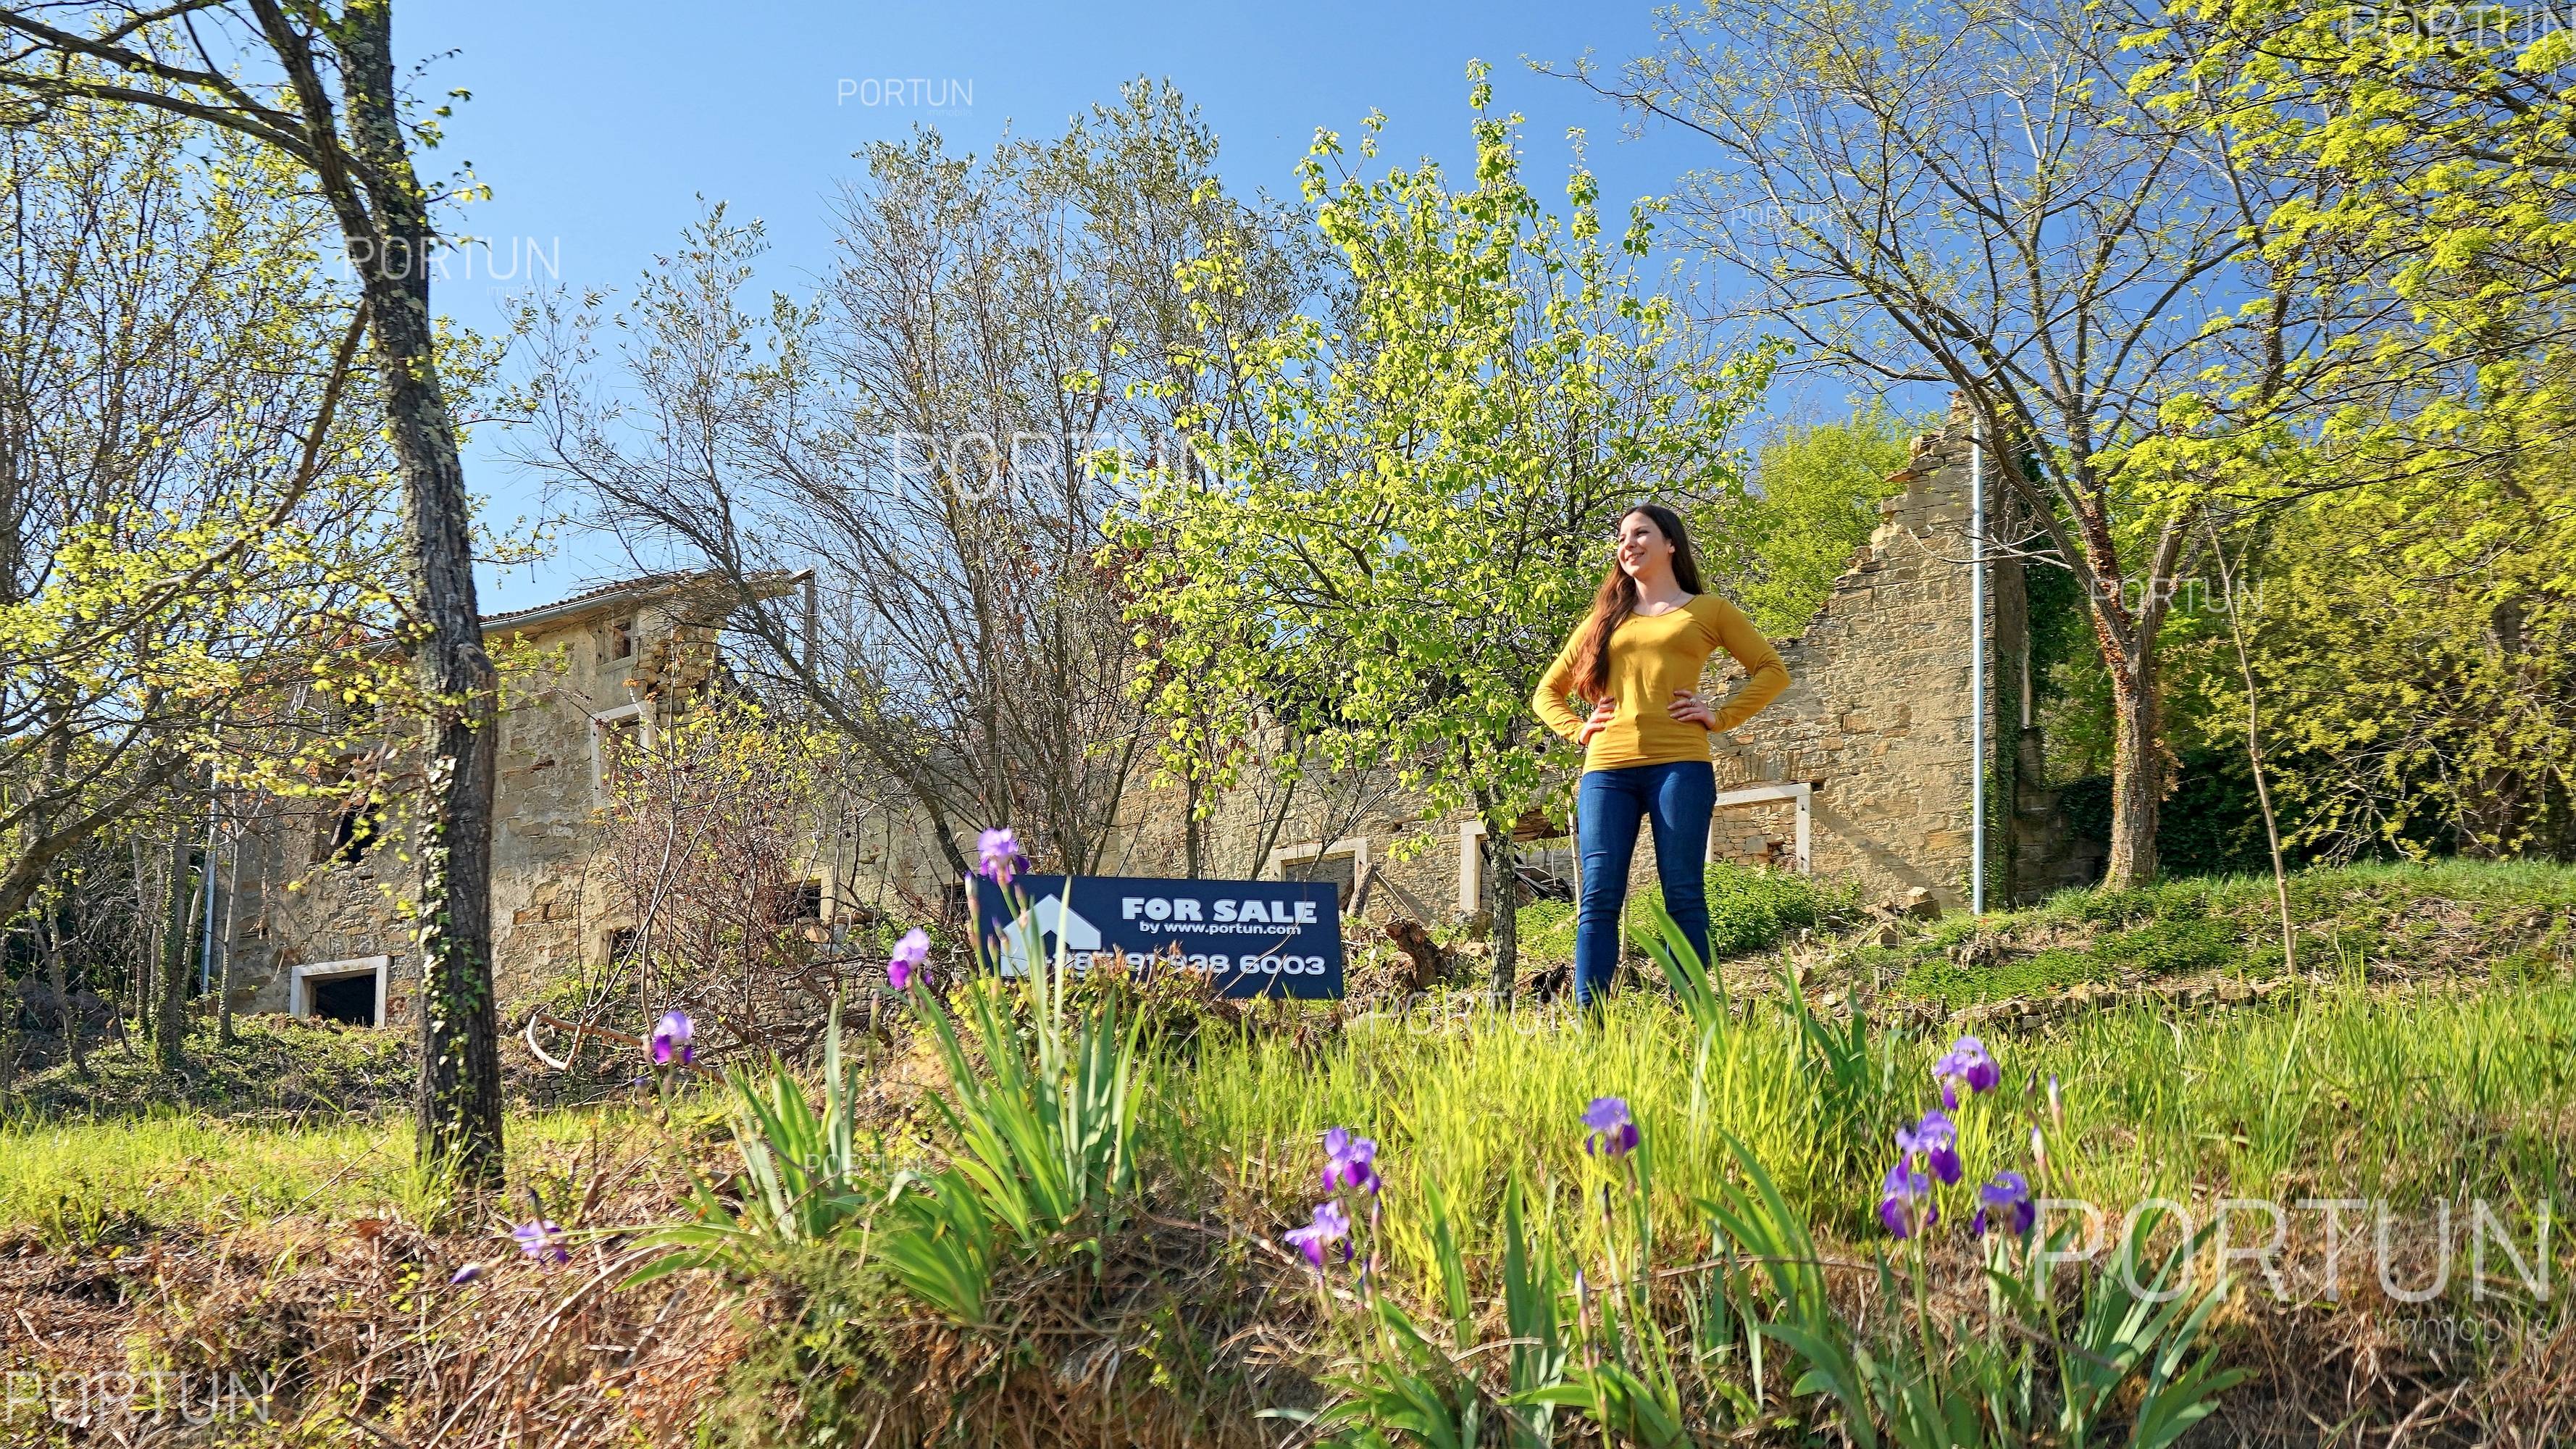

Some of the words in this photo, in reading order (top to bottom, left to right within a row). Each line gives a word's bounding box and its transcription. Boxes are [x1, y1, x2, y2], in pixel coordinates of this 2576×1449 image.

[1122, 898, 1203, 922] FOR
[1213, 898, 1318, 924] SALE
[1139, 920, 1160, 933] by
[1163, 922, 1301, 935] www.portun.com
[1239, 954, 1326, 974] 6003
